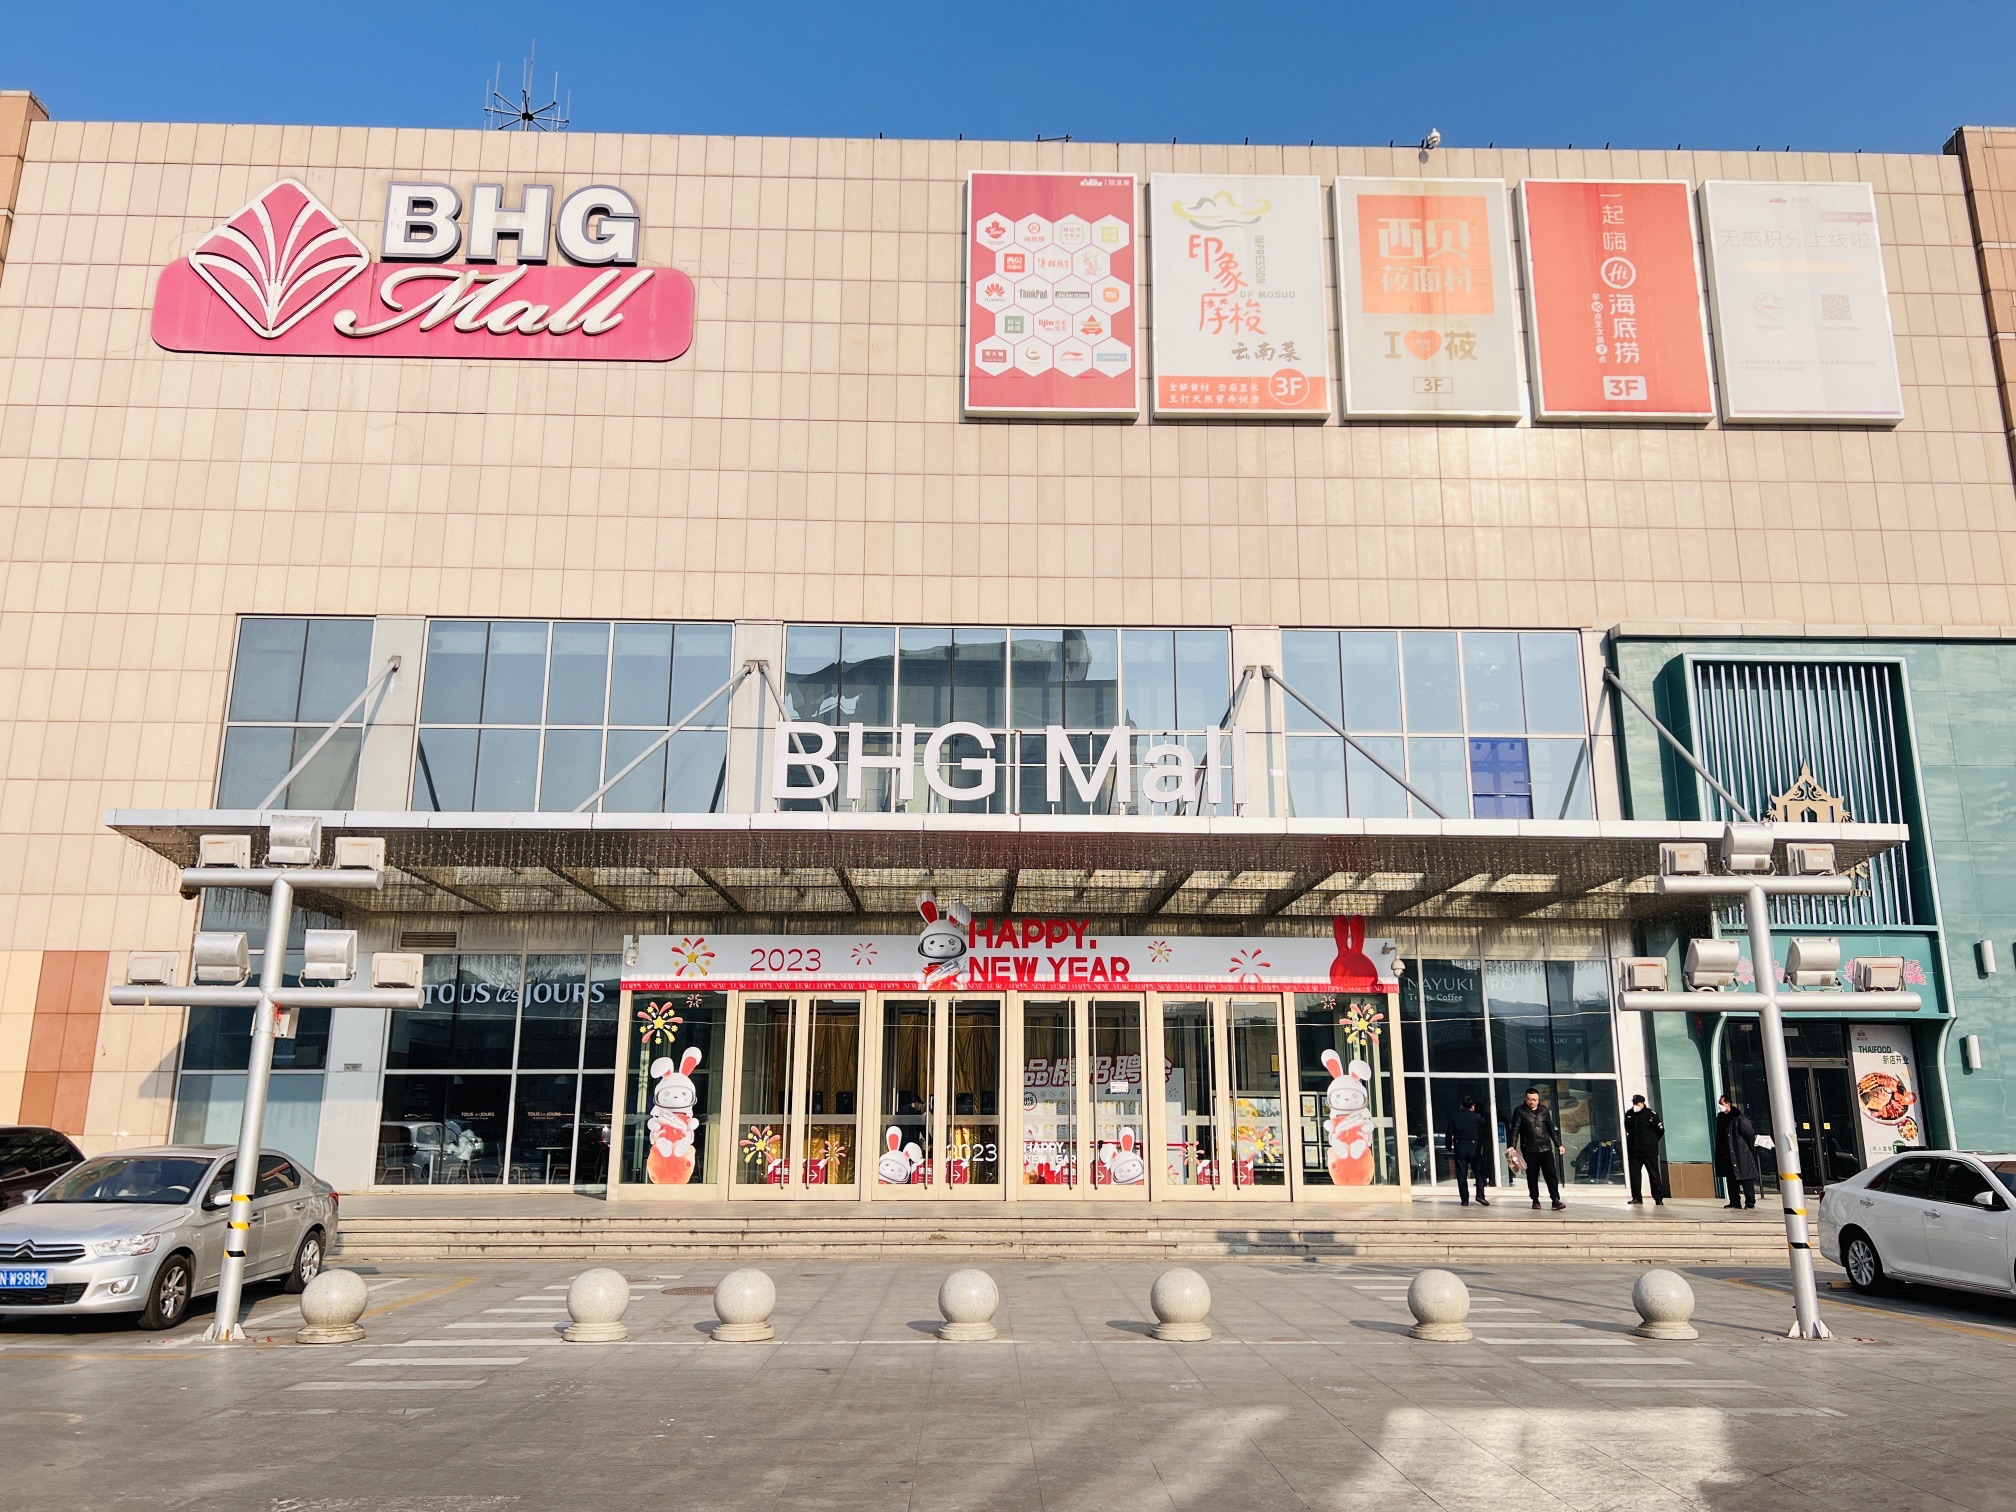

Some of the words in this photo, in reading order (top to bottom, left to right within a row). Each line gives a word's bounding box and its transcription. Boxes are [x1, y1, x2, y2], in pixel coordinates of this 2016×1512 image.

[381, 181, 640, 267] BHG
[1600, 193, 1627, 252] 一起嗨
[1377, 218, 1470, 260] 西贝
[1720, 229, 1872, 249] 无感积分上线啦
[1189, 235, 1249, 293] 印象
[1254, 235, 1266, 283] IMPRESSION
[1381, 265, 1472, 293] 莜面村
[1608, 263, 1629, 282] Hi
[334, 264, 655, 338] Mall
[1239, 291, 1254, 299] OF
[1199, 288, 1268, 335] 摩梭
[1608, 293, 1640, 364] 海底捞
[1231, 341, 1302, 363] 云南菜
[1444, 331, 1478, 360] 莜
[1275, 377, 1303, 397] 3F
[1423, 379, 1443, 392] 3F
[1609, 380, 1639, 397] 3F
[772, 721, 997, 800] BHG
[1046, 725, 1248, 804] Mall
[749, 948, 821, 972] 2023
[969, 957, 1039, 982] NEW
[1047, 957, 1130, 982] YEAR
[422, 983, 490, 1005] TOUS
[496, 982, 519, 1003] les
[525, 983, 605, 1008] JOURS
[1407, 978, 1473, 991] NAYUKI
[1486, 978, 1514, 991] RO
[1437, 993, 1463, 1001] Coffee
[1858, 1046, 1892, 1054] THAIFOOD
[1883, 1055, 1909, 1065] 新店开业
[946, 1144, 998, 1162] 2023
[1024, 1155, 1047, 1164] NEW
